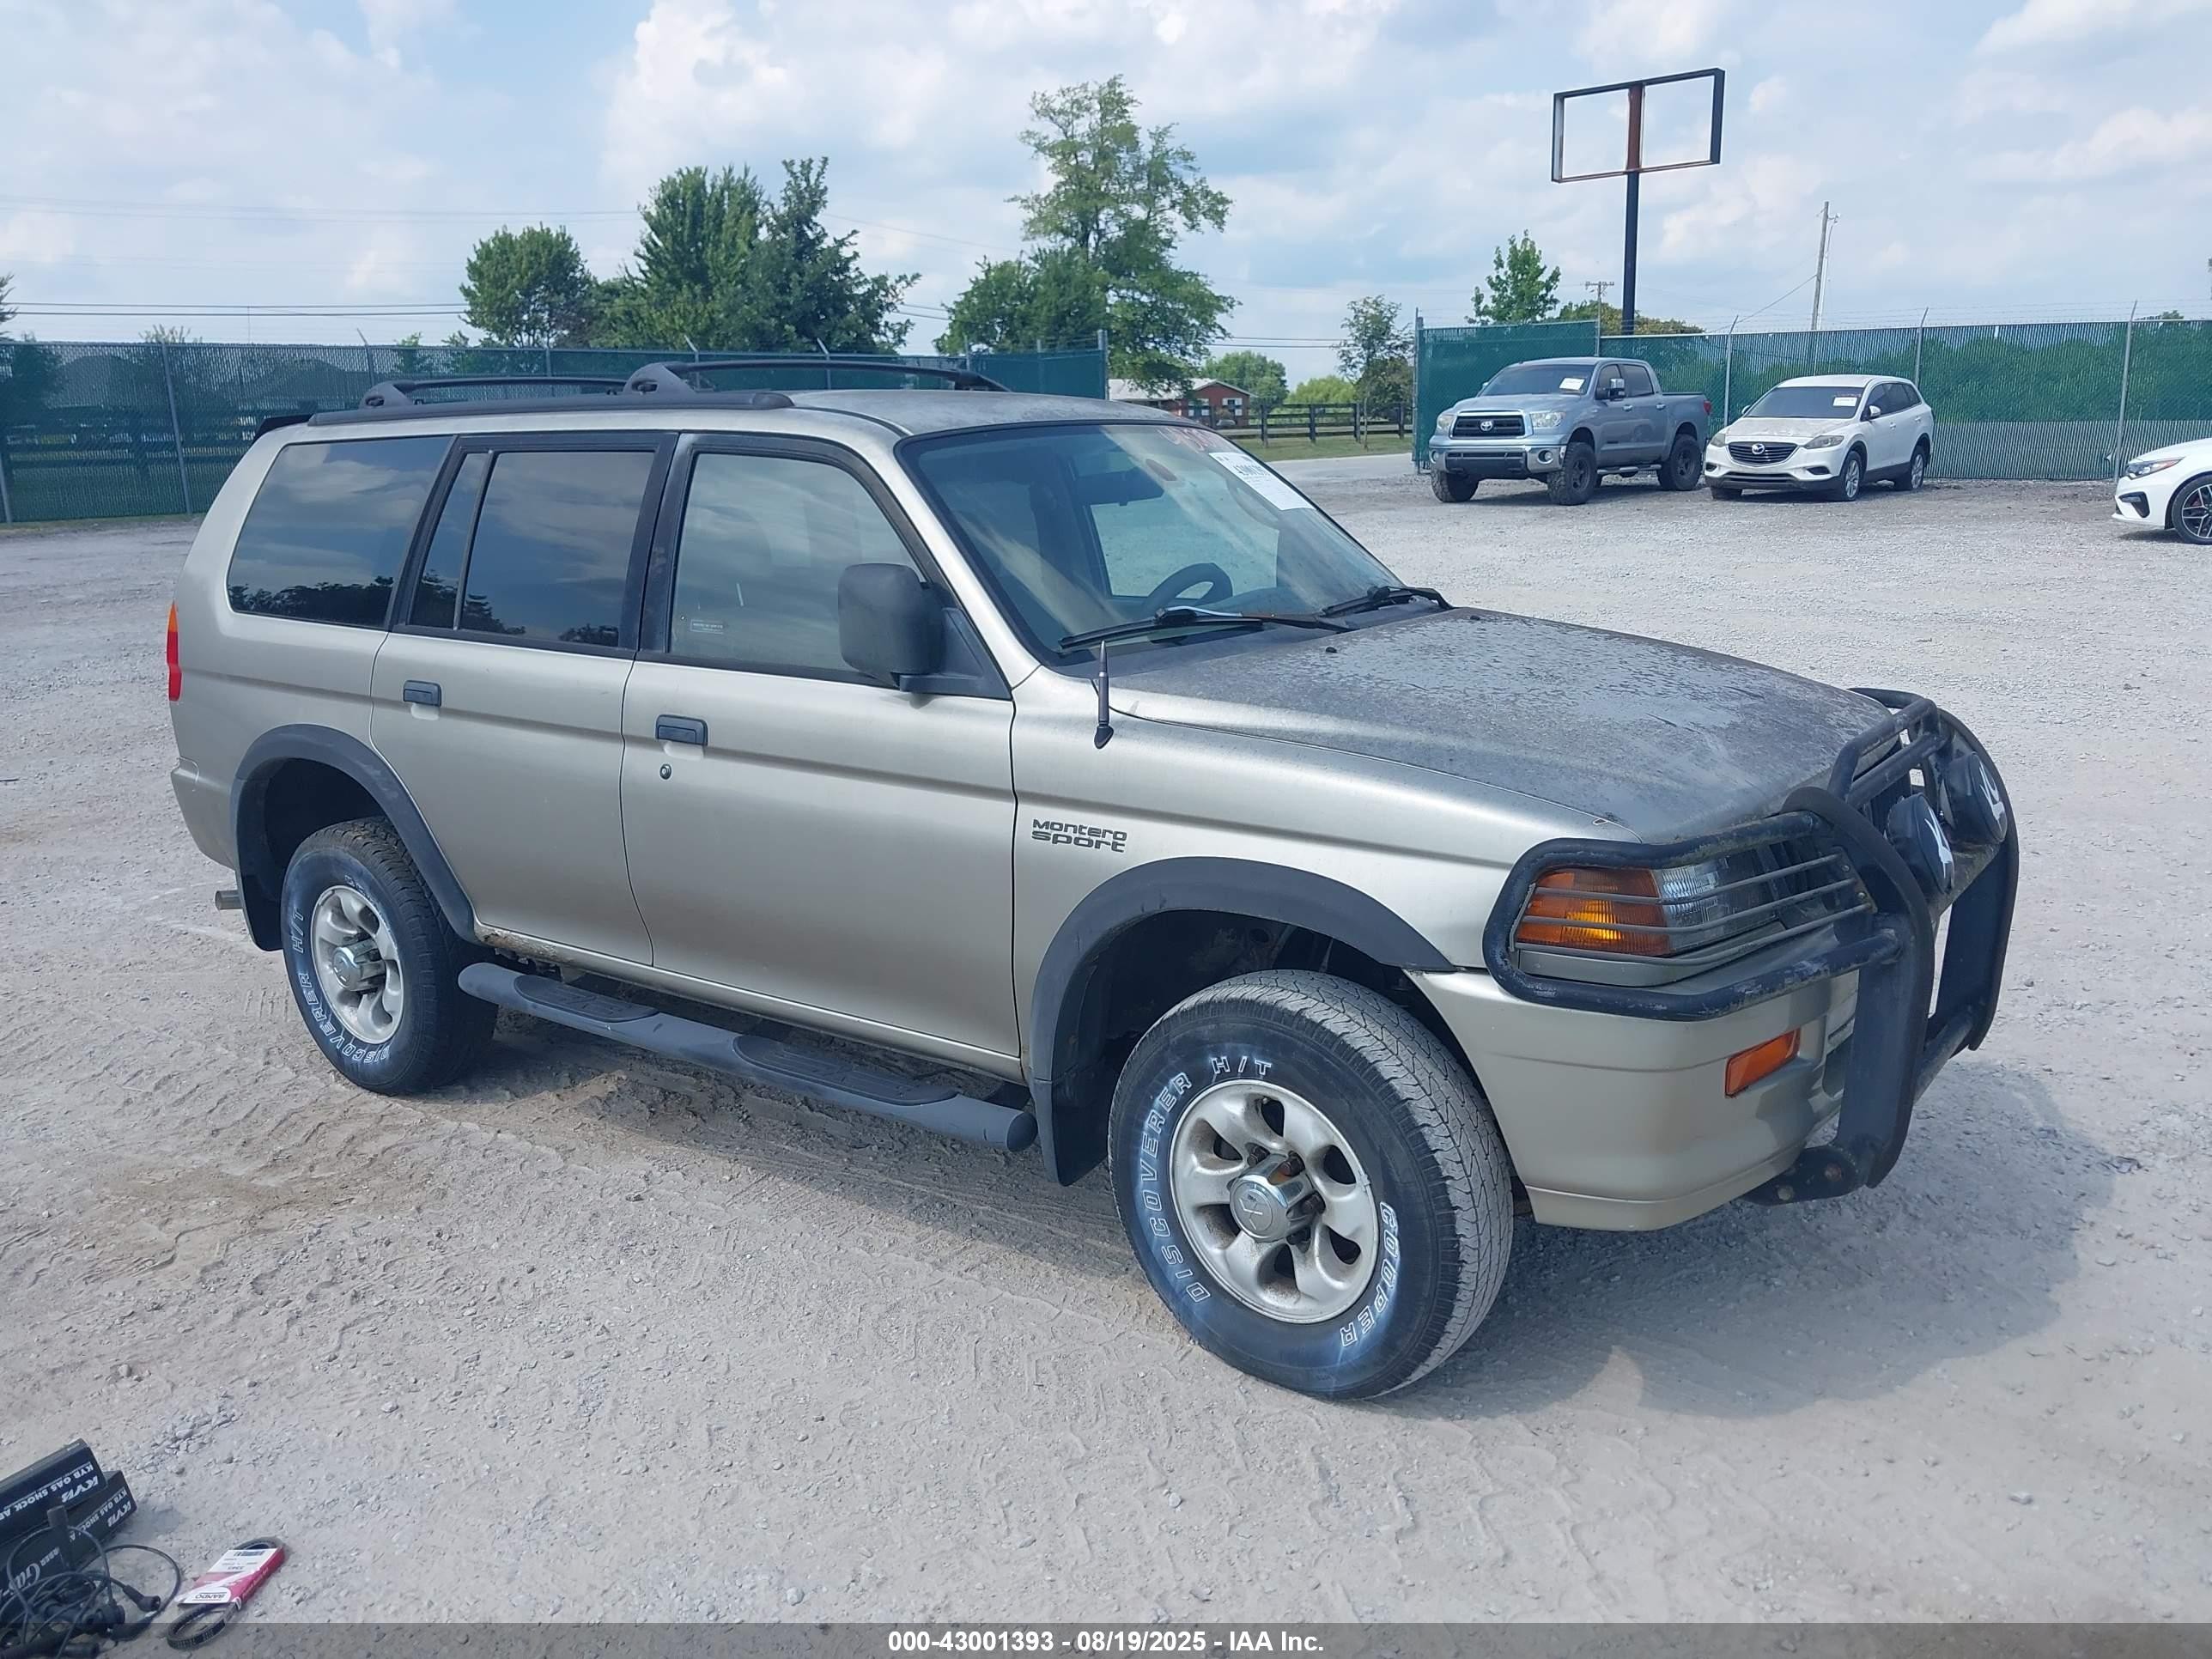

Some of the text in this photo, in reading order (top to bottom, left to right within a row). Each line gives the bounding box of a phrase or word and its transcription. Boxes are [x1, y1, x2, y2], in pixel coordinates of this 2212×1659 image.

[1032, 819, 1127, 842] Montero
[299, 972, 390, 1064] DISCOVERER
[1139, 1056, 1273, 1303] DISCOVERER H/T
[1340, 1201, 1400, 1347] COOPER
[15, 1490, 48, 1512] SHOCK
